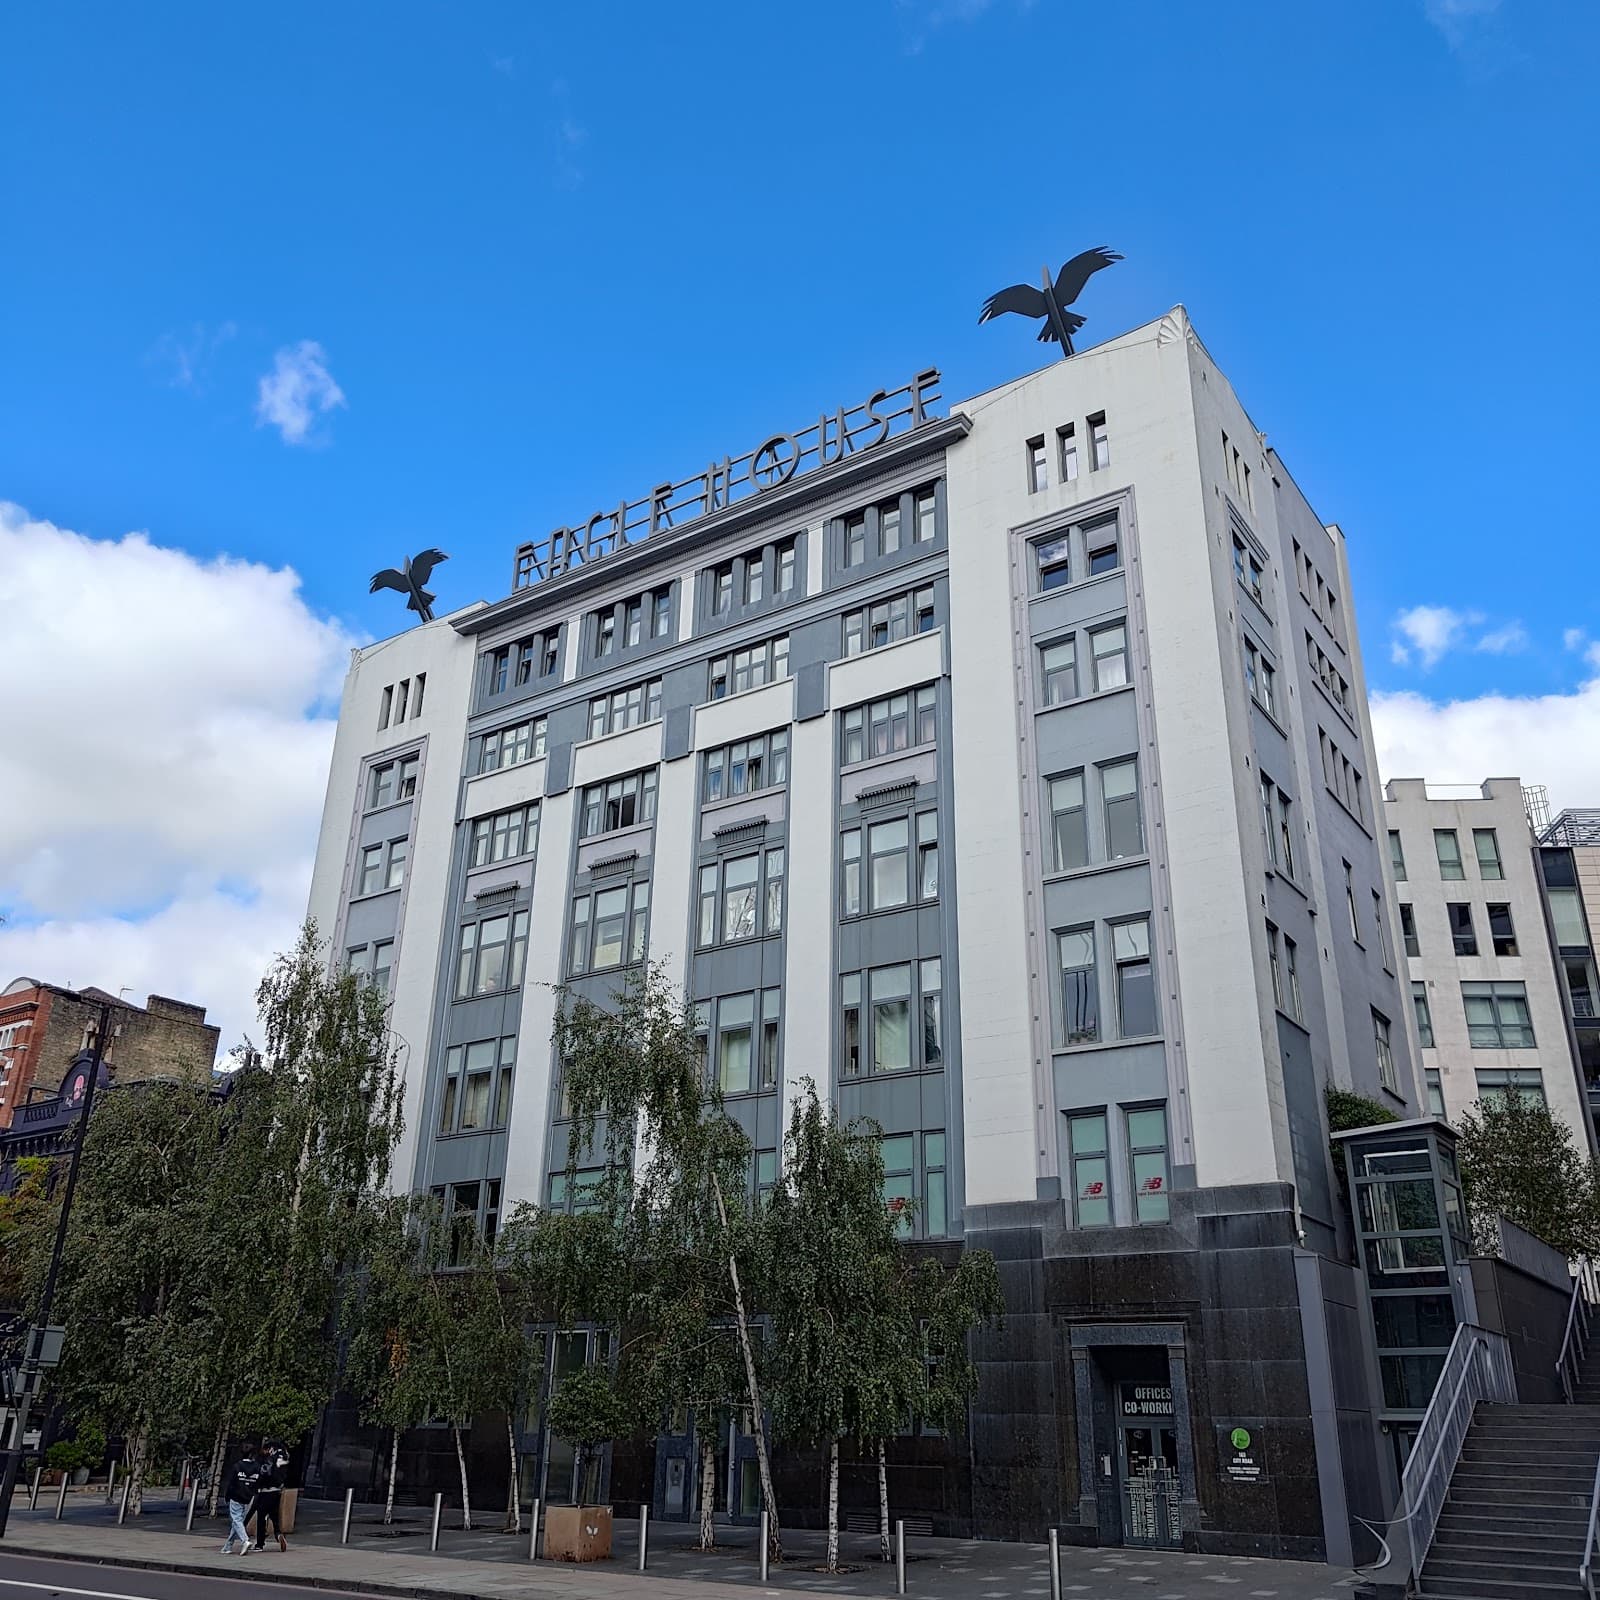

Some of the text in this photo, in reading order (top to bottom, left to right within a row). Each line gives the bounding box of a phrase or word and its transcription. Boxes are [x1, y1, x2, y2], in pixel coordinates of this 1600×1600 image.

[512, 366, 940, 597] EAGLE HOUSE
[1135, 1387, 1172, 1400] OFFICES
